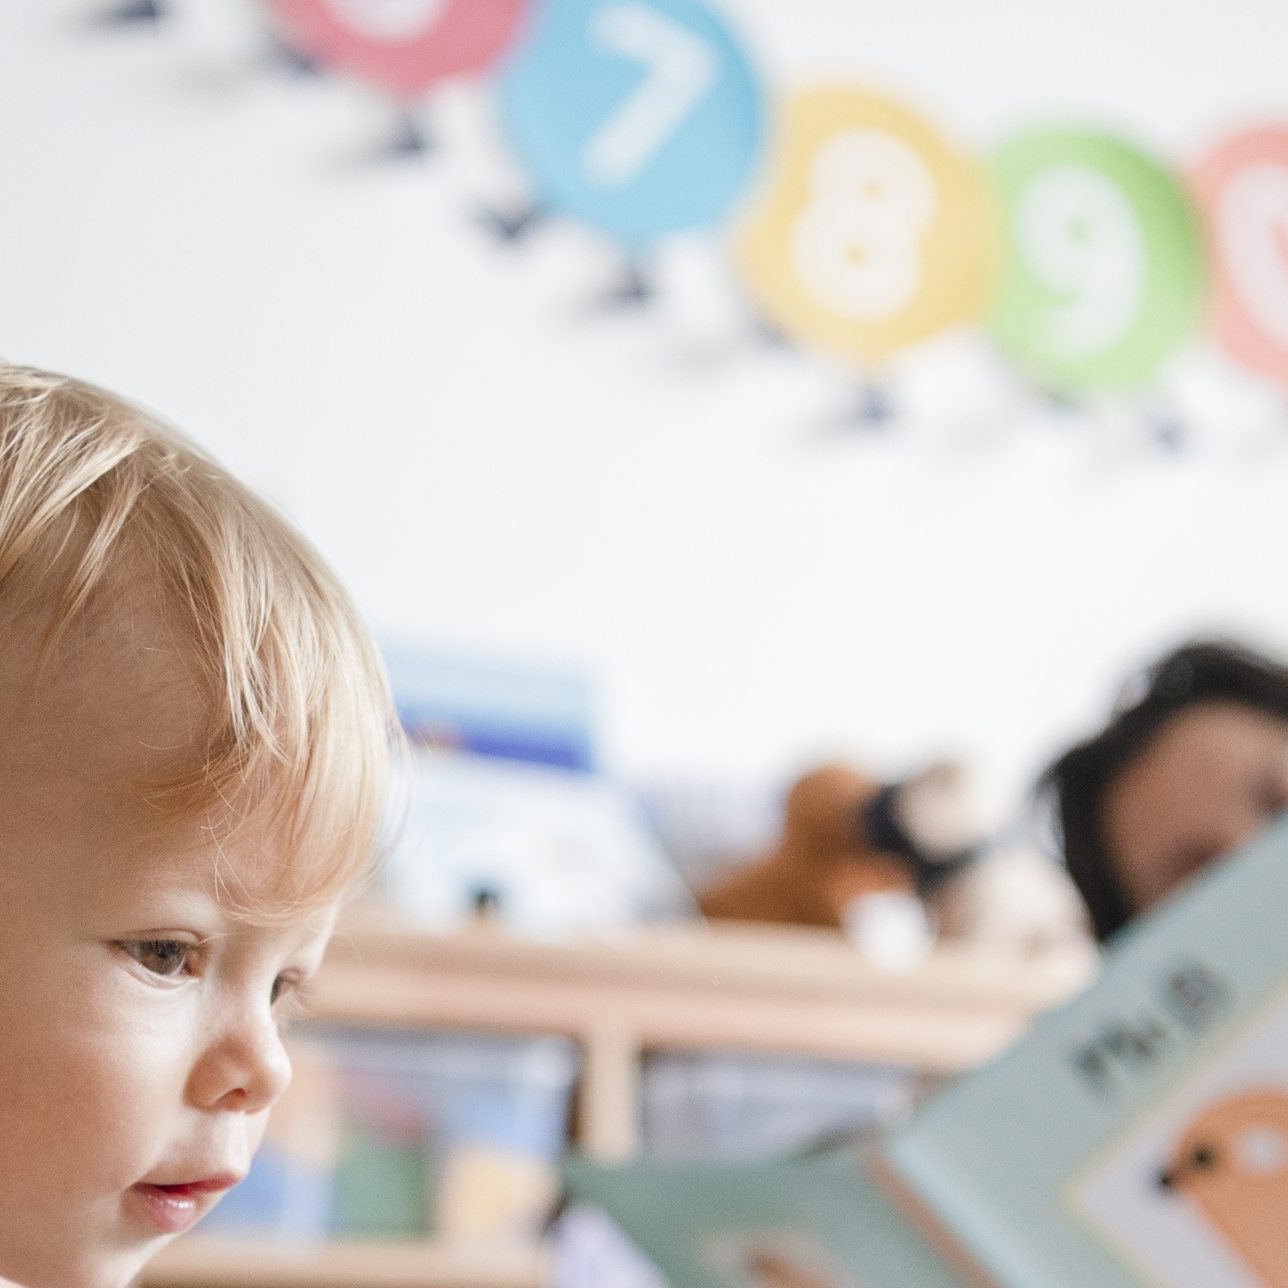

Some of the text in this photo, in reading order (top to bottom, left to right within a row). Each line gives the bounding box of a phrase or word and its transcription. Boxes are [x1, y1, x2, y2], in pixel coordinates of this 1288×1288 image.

[586, 2, 715, 184] 7
[791, 128, 934, 322] 8
[1015, 165, 1146, 360] 9
